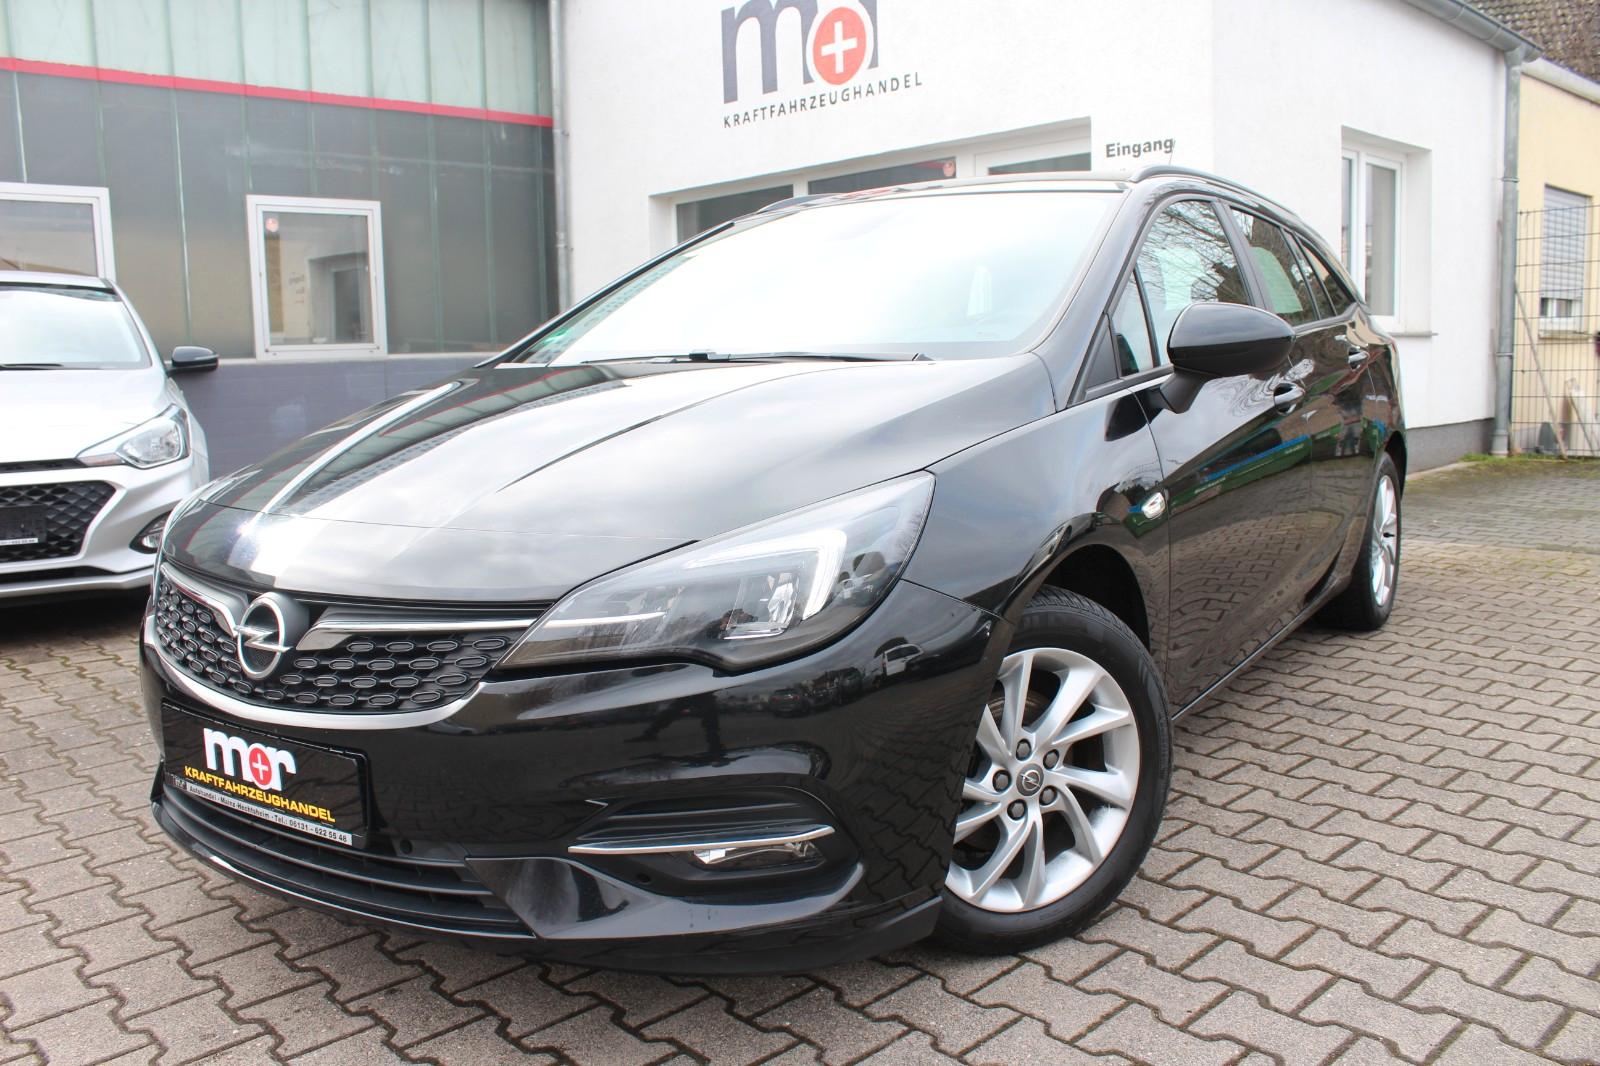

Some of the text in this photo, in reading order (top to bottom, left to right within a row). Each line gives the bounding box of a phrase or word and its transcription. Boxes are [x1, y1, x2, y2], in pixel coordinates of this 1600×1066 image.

[723, 72, 922, 129] KRAFTFAHRZEUGHANDEL
[1105, 138, 1174, 158] Eingang
[184, 765, 336, 823] KRAFTFAHRZEUGHANDEL
[289, 819, 308, 831] 06131
[314, 827, 327, 837] 622
[328, 831, 337, 840] 55
[338, 834, 347, 843] 48
